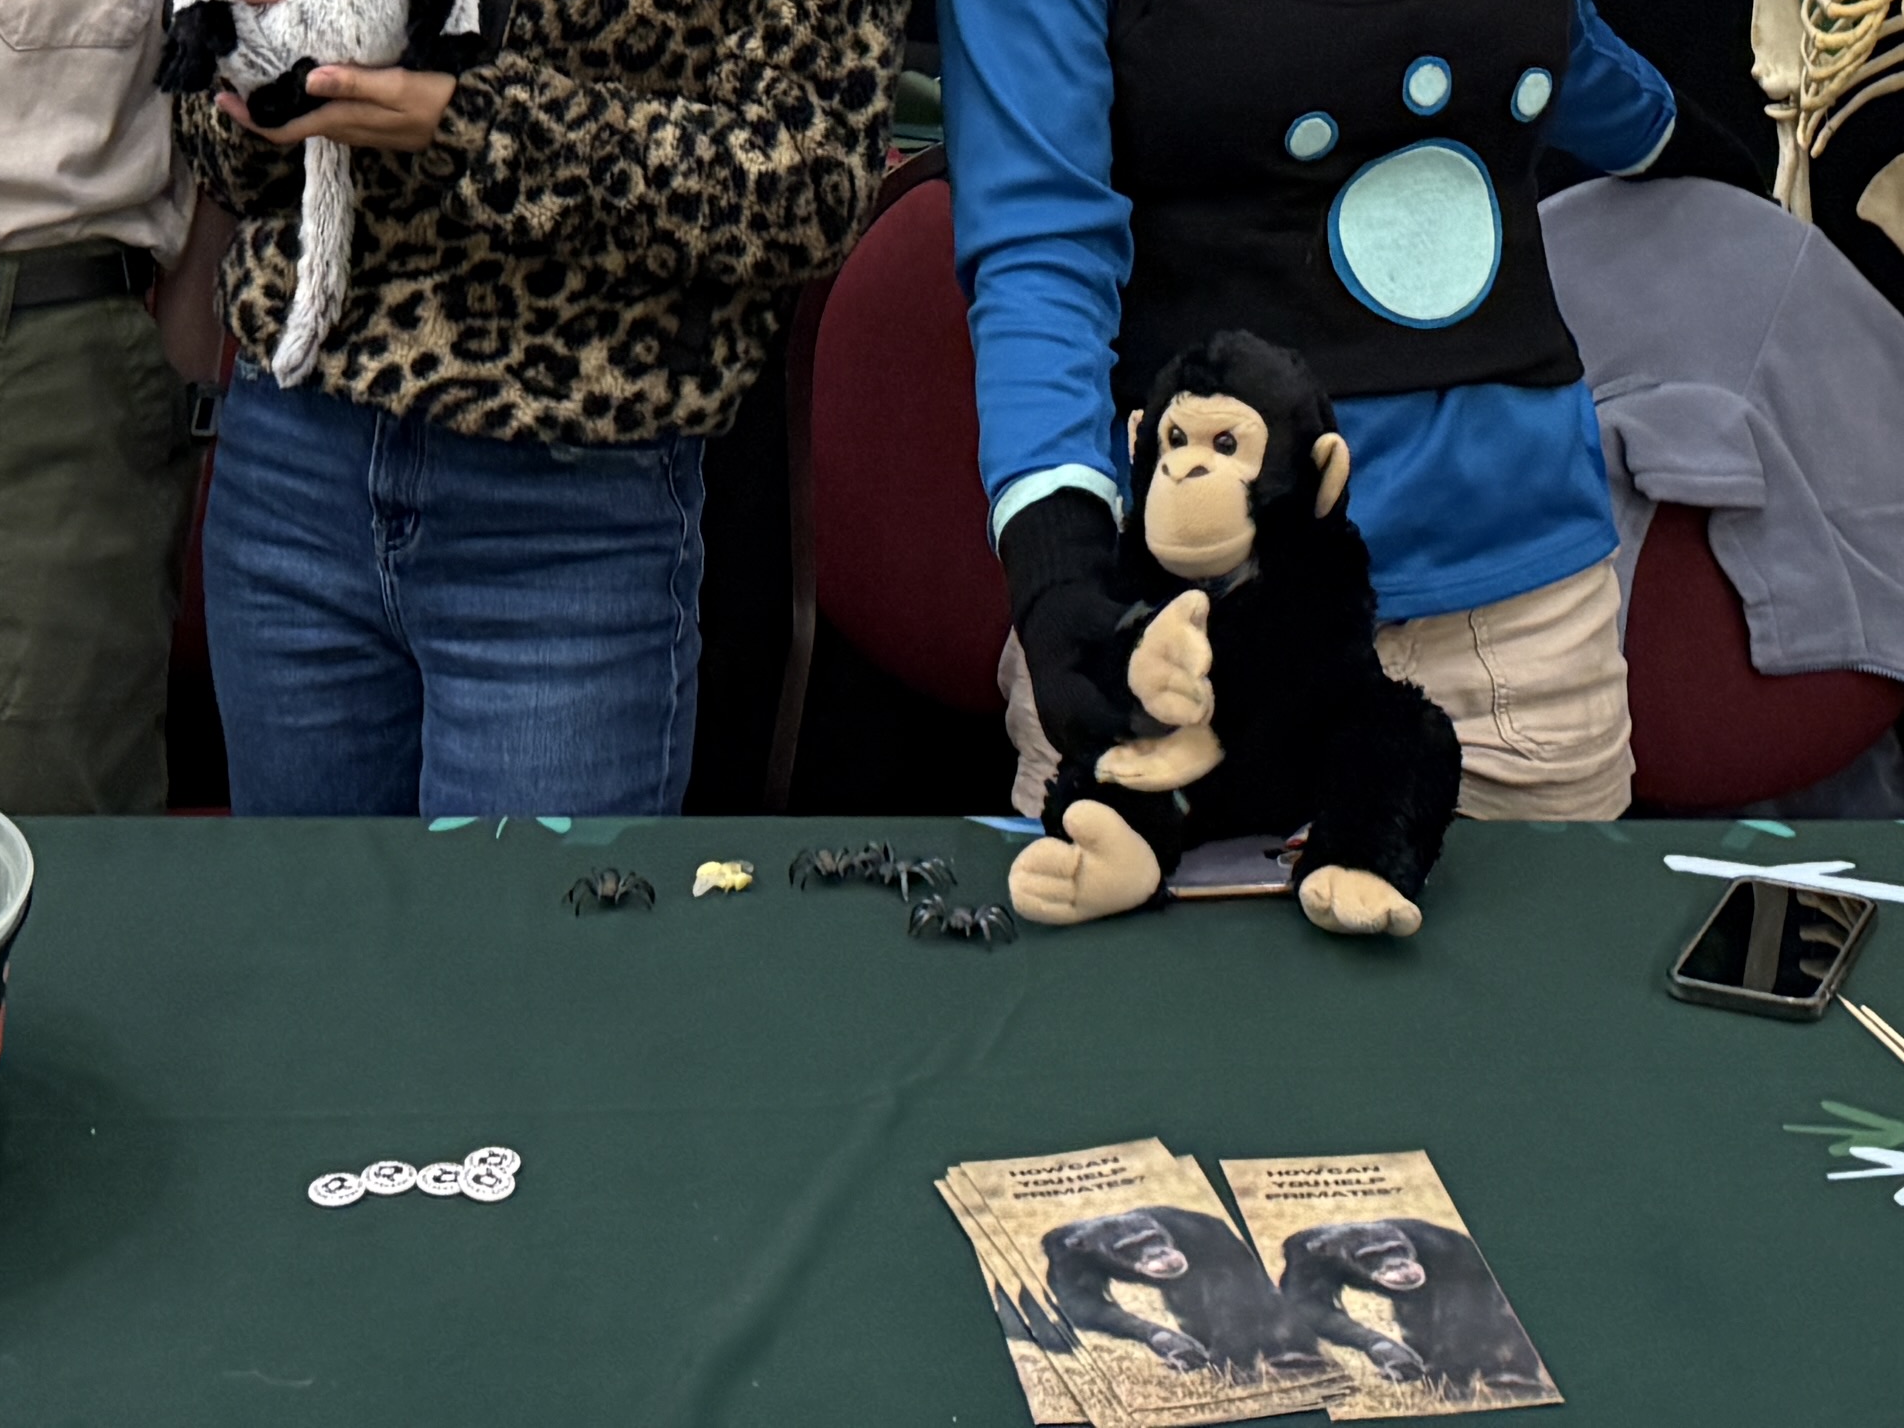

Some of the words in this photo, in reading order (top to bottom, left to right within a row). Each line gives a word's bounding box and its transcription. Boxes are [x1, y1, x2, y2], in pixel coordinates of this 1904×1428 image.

[1009, 1163, 1064, 1177] HOW
[1068, 1156, 1119, 1170] CAN
[1266, 1165, 1323, 1177] HOW
[1327, 1166, 1380, 1174] CAN
[1017, 1177, 1064, 1188] YOU
[1066, 1167, 1127, 1183] HELP
[1272, 1180, 1320, 1188] YOU
[1323, 1177, 1386, 1187] HELP
